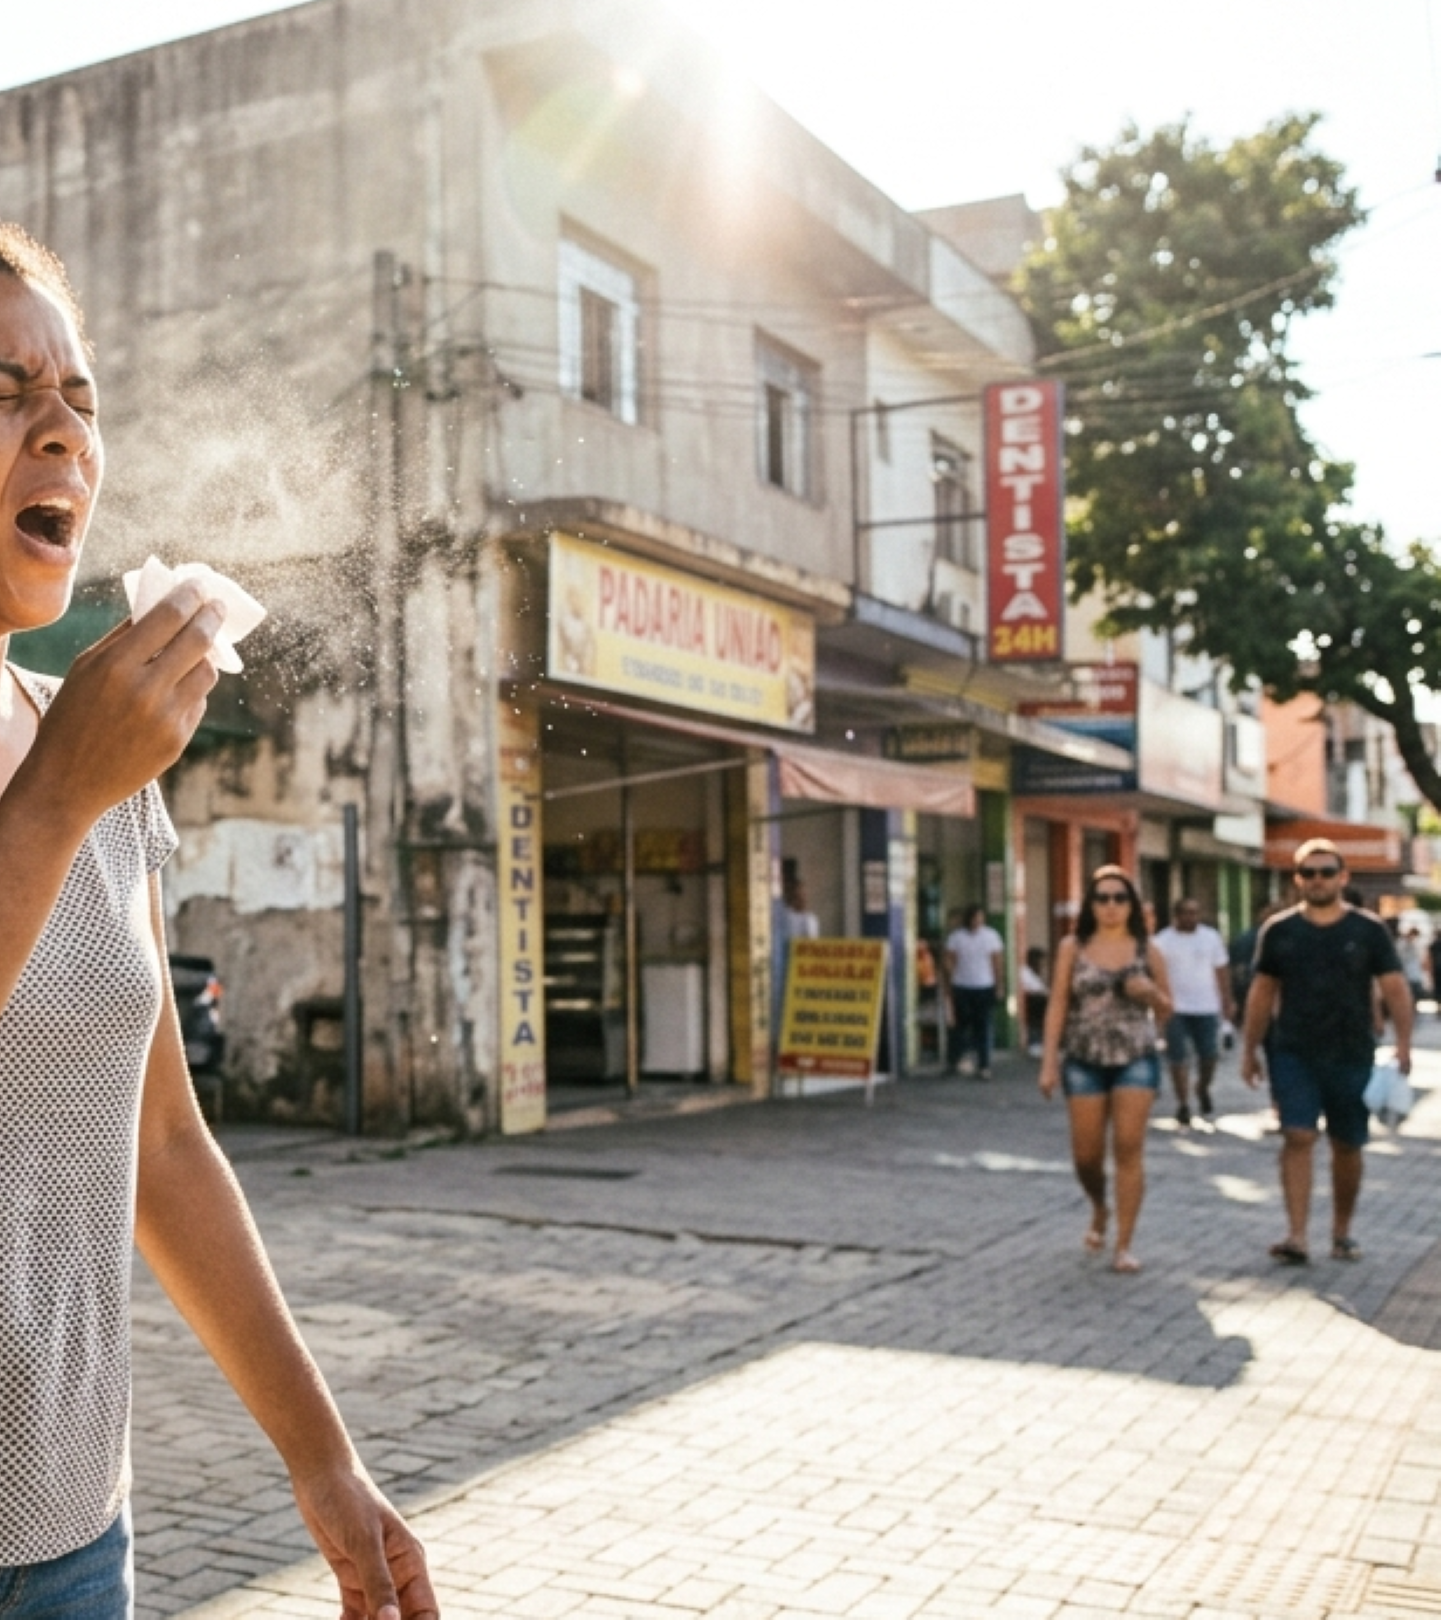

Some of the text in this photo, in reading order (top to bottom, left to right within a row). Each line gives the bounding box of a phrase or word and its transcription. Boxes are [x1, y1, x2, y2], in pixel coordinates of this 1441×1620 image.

[999, 385, 1047, 620] DENTISTA
[598, 564, 708, 656] PADARIA
[993, 624, 1056, 655] 24H
[511, 805, 535, 1046] DENTISTA
